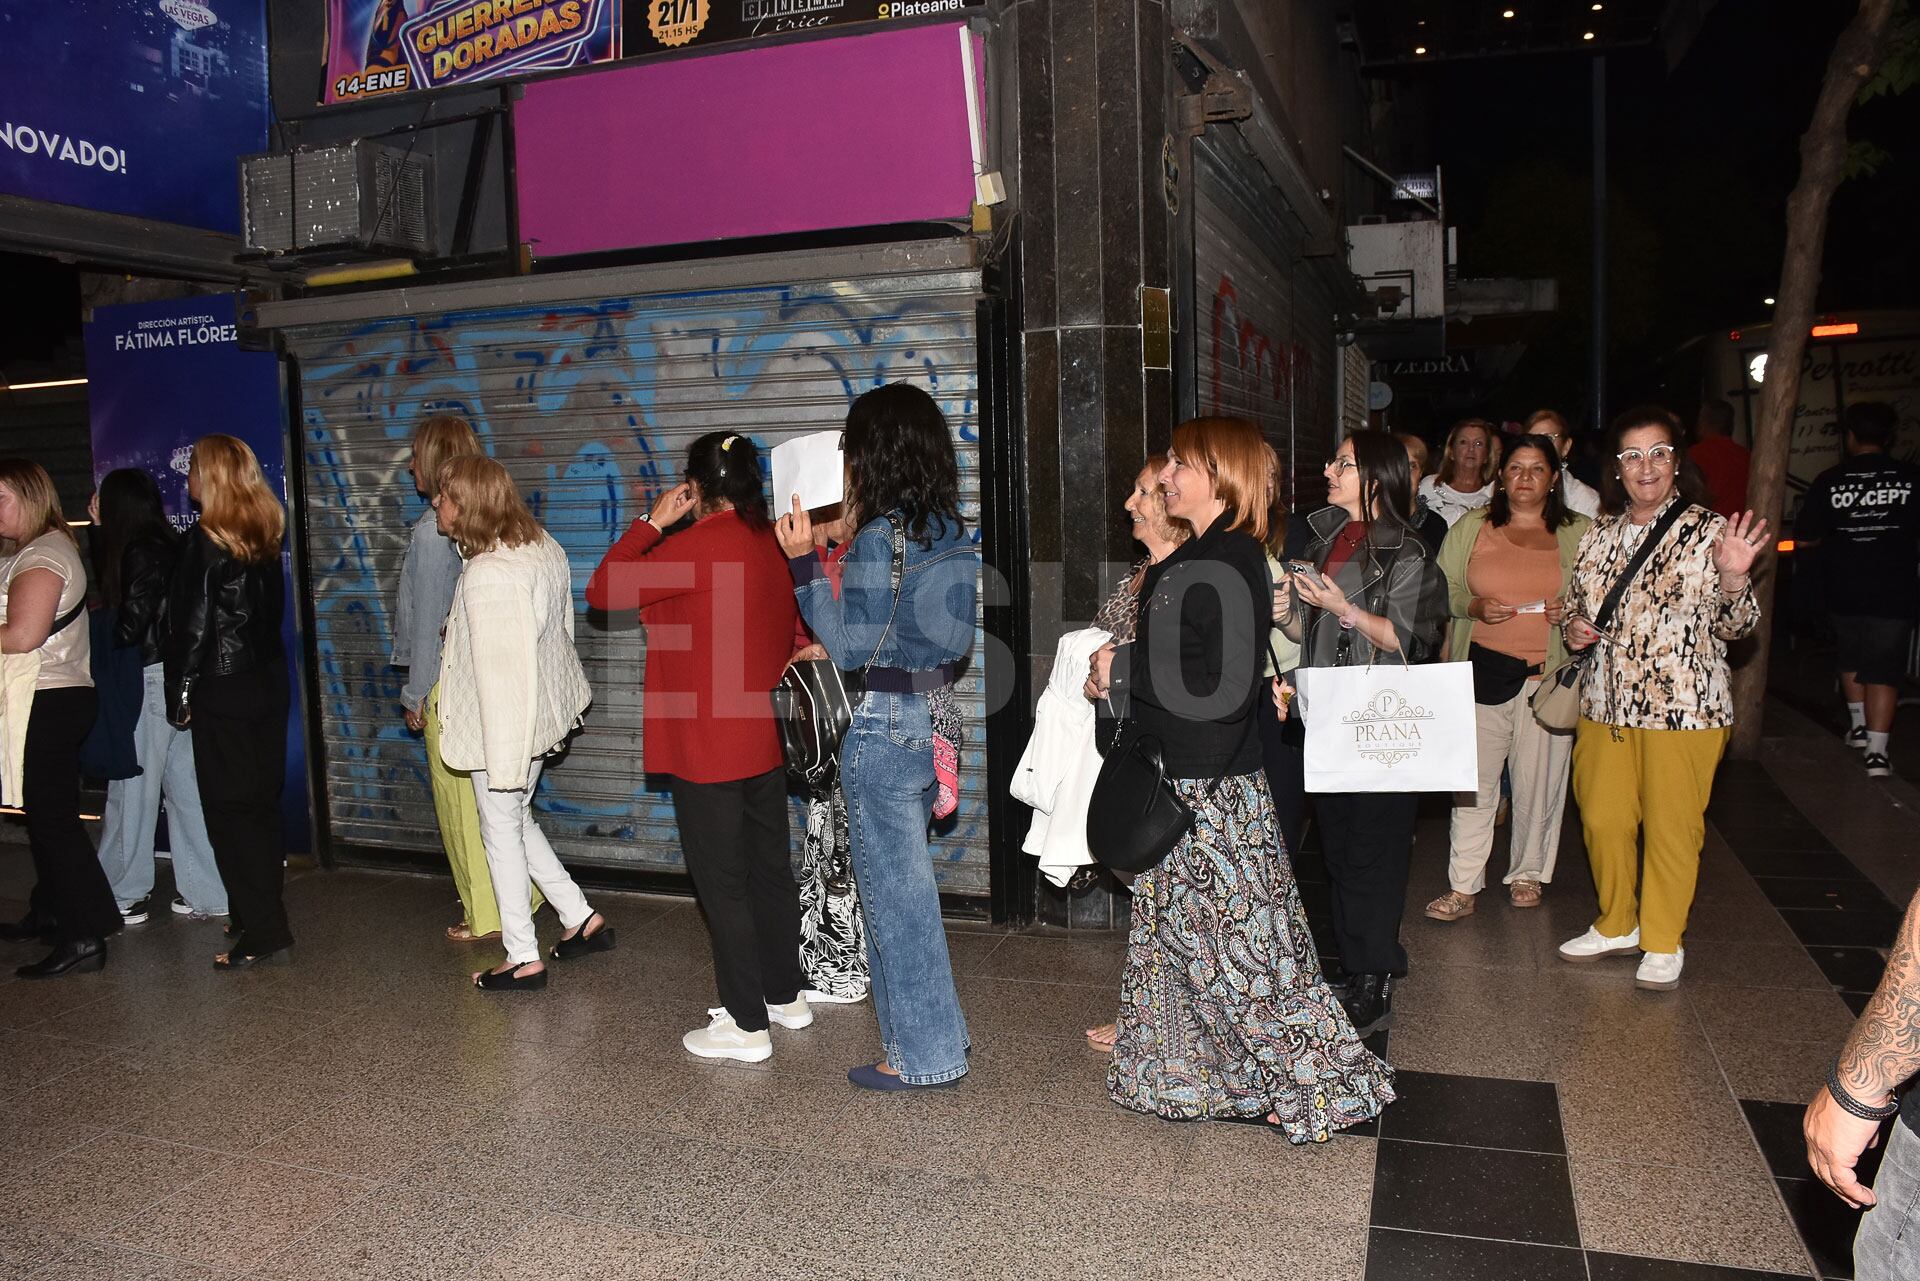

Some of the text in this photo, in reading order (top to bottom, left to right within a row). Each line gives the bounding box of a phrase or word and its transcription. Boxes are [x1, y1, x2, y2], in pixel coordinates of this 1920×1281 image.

[164, 5, 179, 16] LAS
[180, 9, 210, 25] VEGAS
[658, 0, 699, 27] 21/1
[891, 0, 965, 18] Plateanet
[433, 1, 582, 79] DORADAS
[659, 25, 698, 40] 21.15 HS
[336, 69, 406, 96] 14-ENE
[138, 315, 215, 330] DIRECCIÓN ARTÍSTICA
[115, 330, 175, 351] FÁTIMA
[1383, 696, 1392, 712] P
[1355, 723, 1422, 742] PRANA
